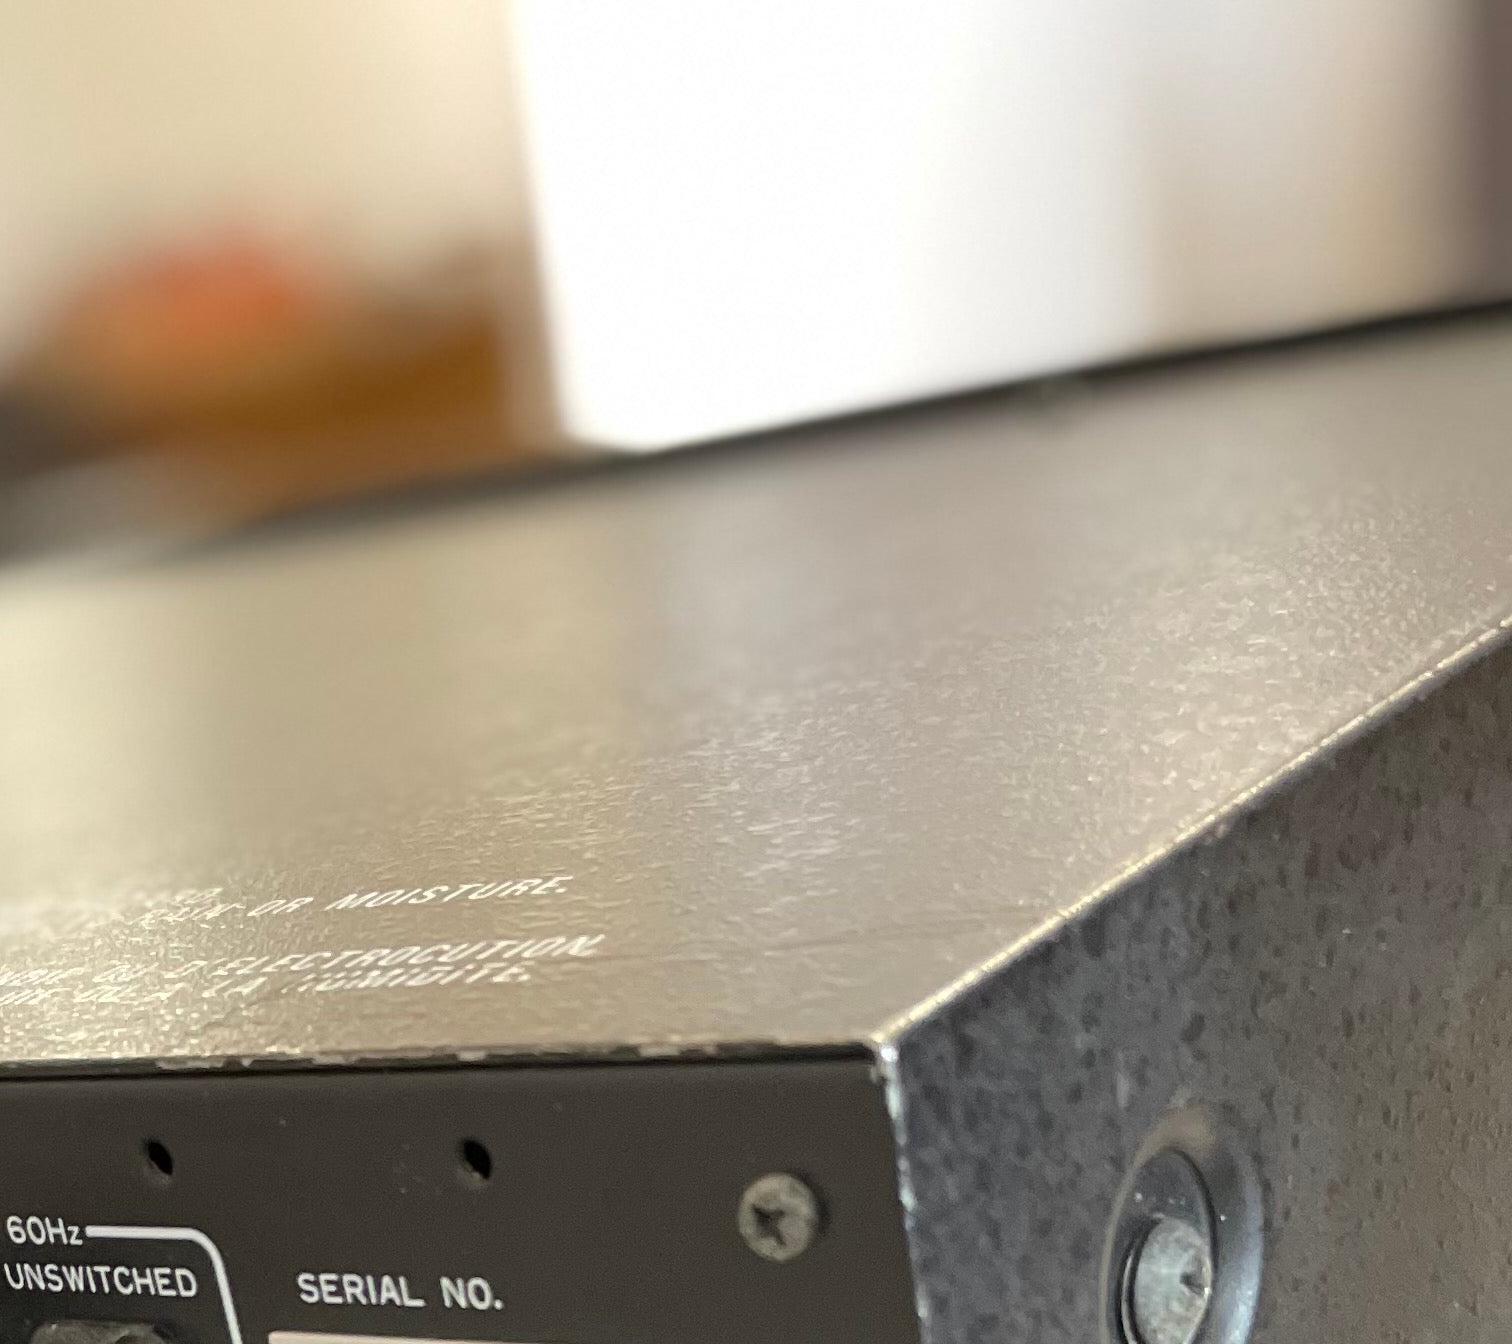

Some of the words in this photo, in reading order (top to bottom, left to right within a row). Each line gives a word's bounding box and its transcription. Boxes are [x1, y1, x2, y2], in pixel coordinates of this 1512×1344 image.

[325, 876, 573, 912] MOISTURE.
[6, 1215, 83, 1246] 60Hz
[3, 1262, 198, 1298] UNSWITCHED
[297, 1272, 426, 1307] SERIAL
[439, 1276, 503, 1310] NO.
